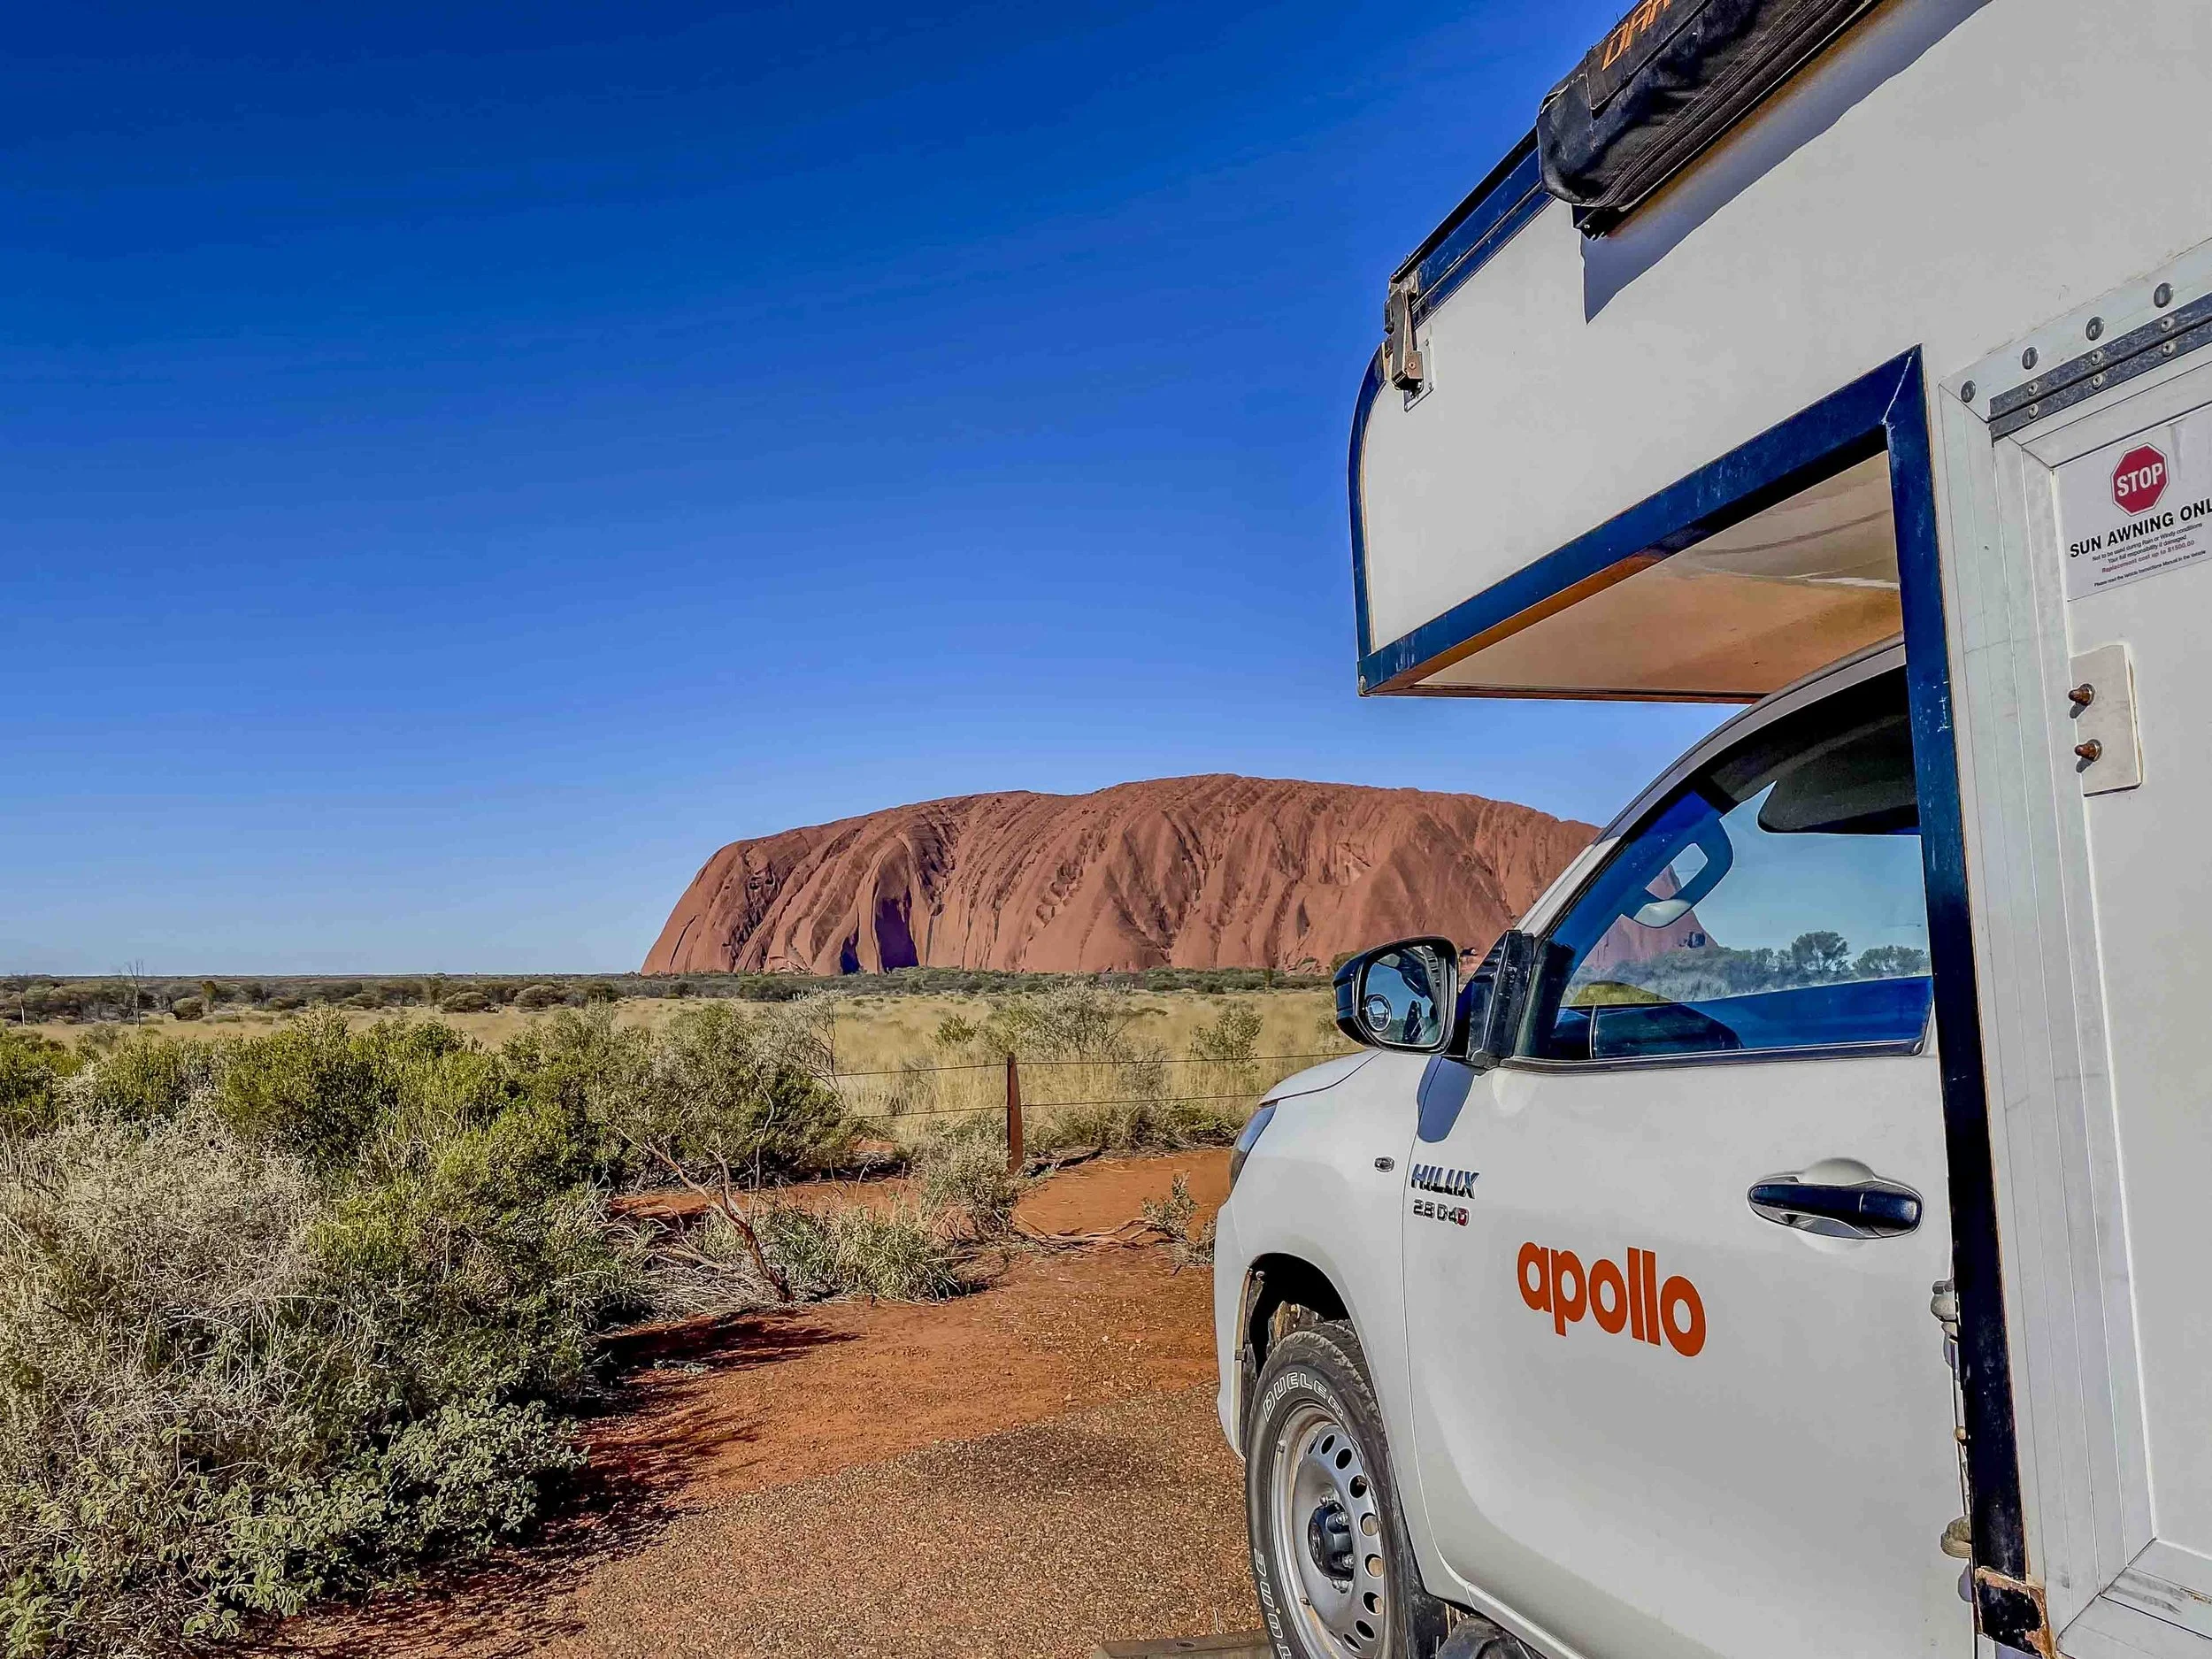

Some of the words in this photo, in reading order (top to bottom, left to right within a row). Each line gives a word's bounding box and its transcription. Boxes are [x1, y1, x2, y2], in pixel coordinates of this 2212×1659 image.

[2116, 463, 2163, 497] STOP
[2070, 535, 2102, 557] SUN
[2107, 511, 2174, 547] AWNING
[1410, 1164, 1480, 1199] HILUX
[1517, 1241, 1707, 1357] apollo
[1263, 1371, 1344, 1423] DUELER
